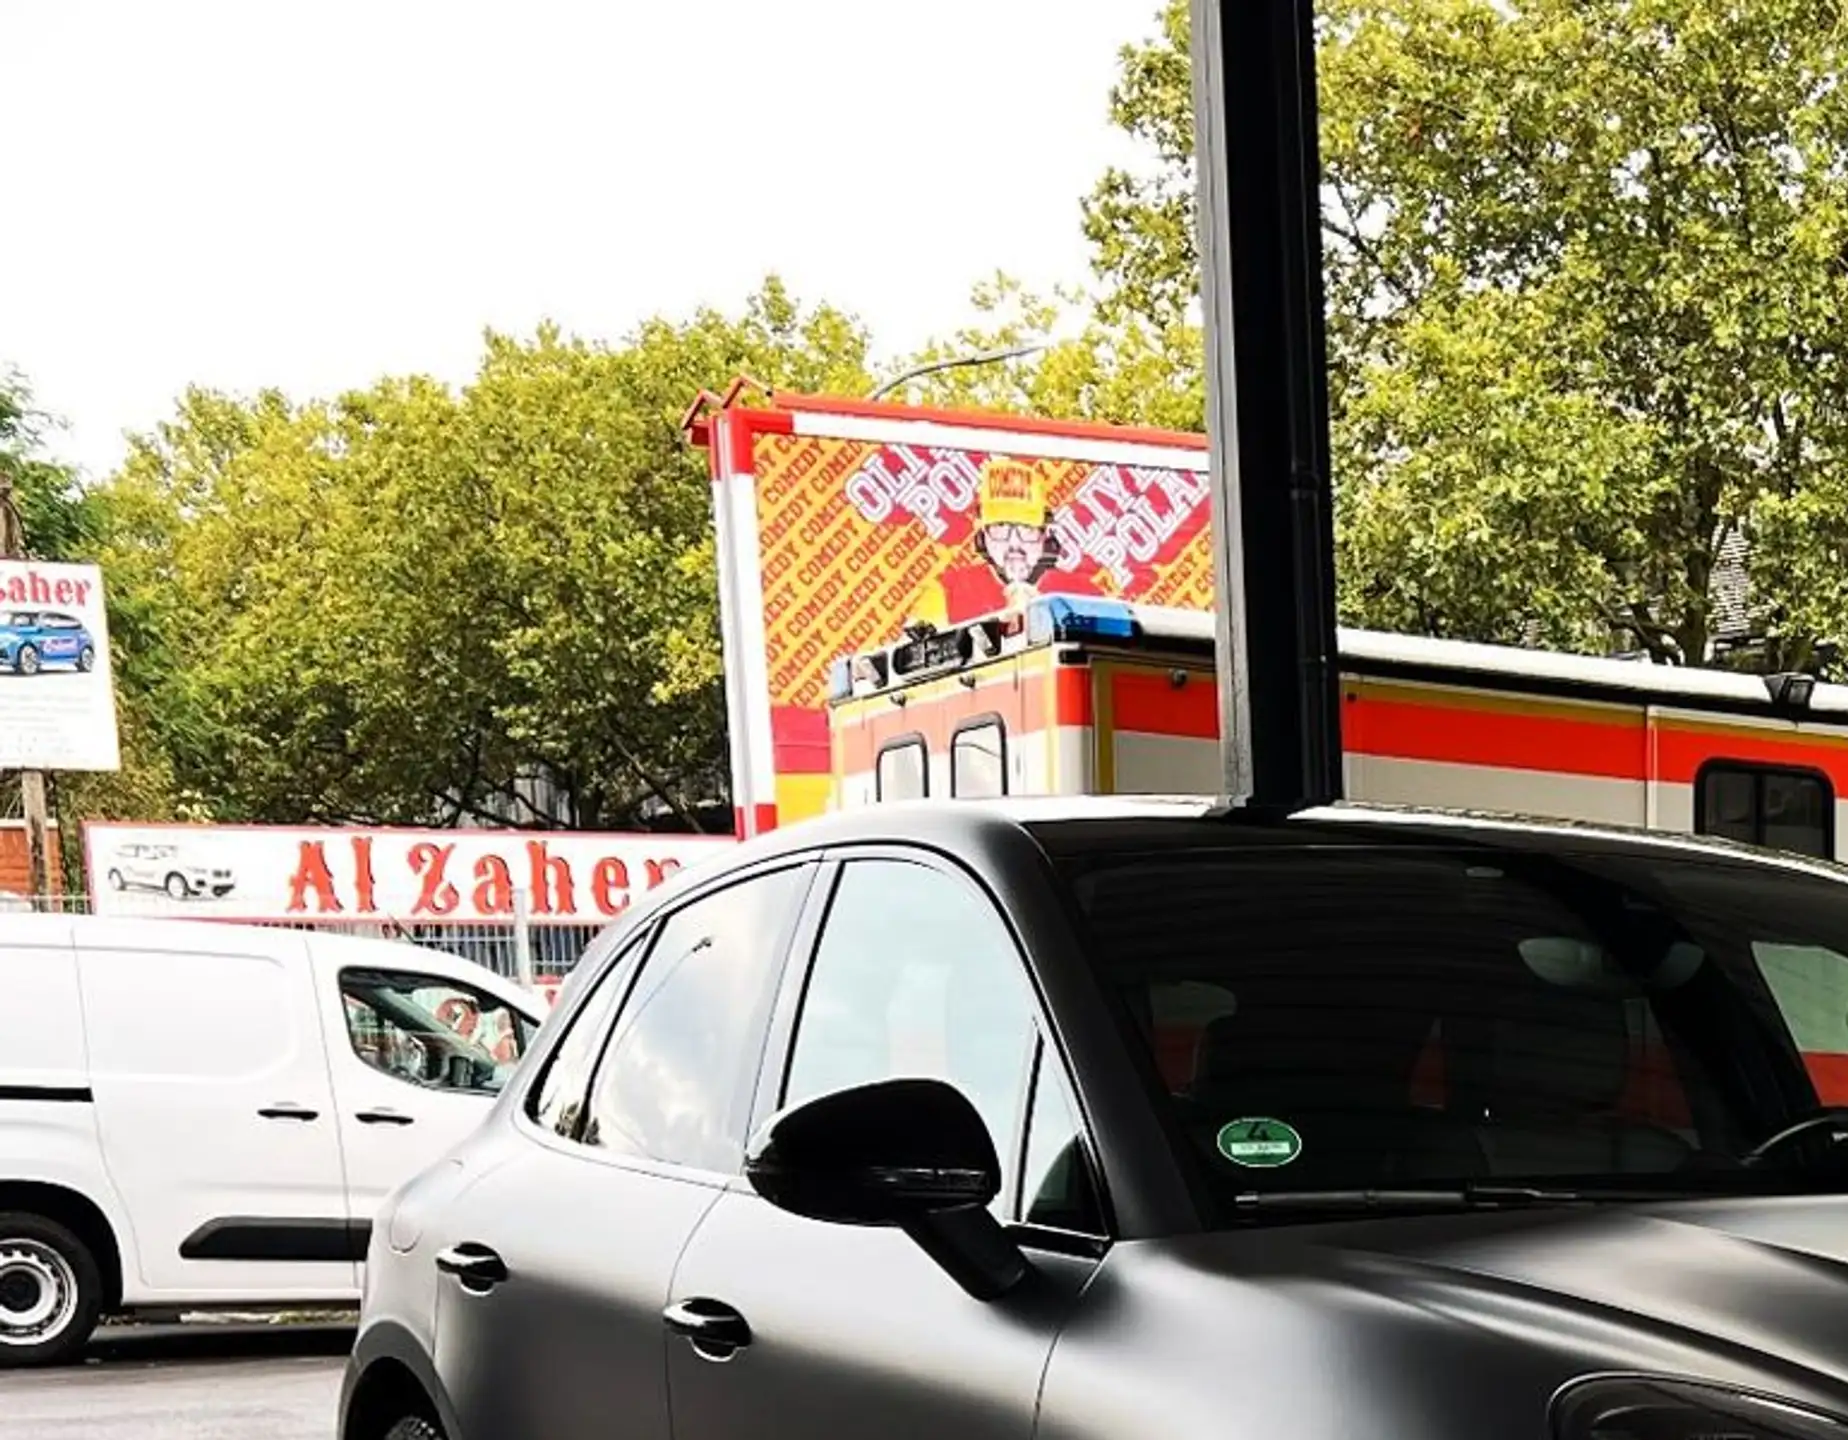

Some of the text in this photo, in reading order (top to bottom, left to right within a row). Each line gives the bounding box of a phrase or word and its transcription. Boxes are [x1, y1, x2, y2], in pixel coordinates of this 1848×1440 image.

[761, 439, 826, 506] COMEDY
[1046, 465, 1088, 508] OMED
[758, 489, 815, 557] OMEDY
[795, 518, 861, 588] COMEDY
[1090, 470, 1210, 588] POLA
[0, 571, 91, 606] aher
[783, 568, 851, 639] COMEDY
[823, 564, 889, 635] COMEDY
[878, 544, 942, 613] COMEDY
[1145, 552, 1198, 603] OMEDY
[286, 836, 378, 913] Al
